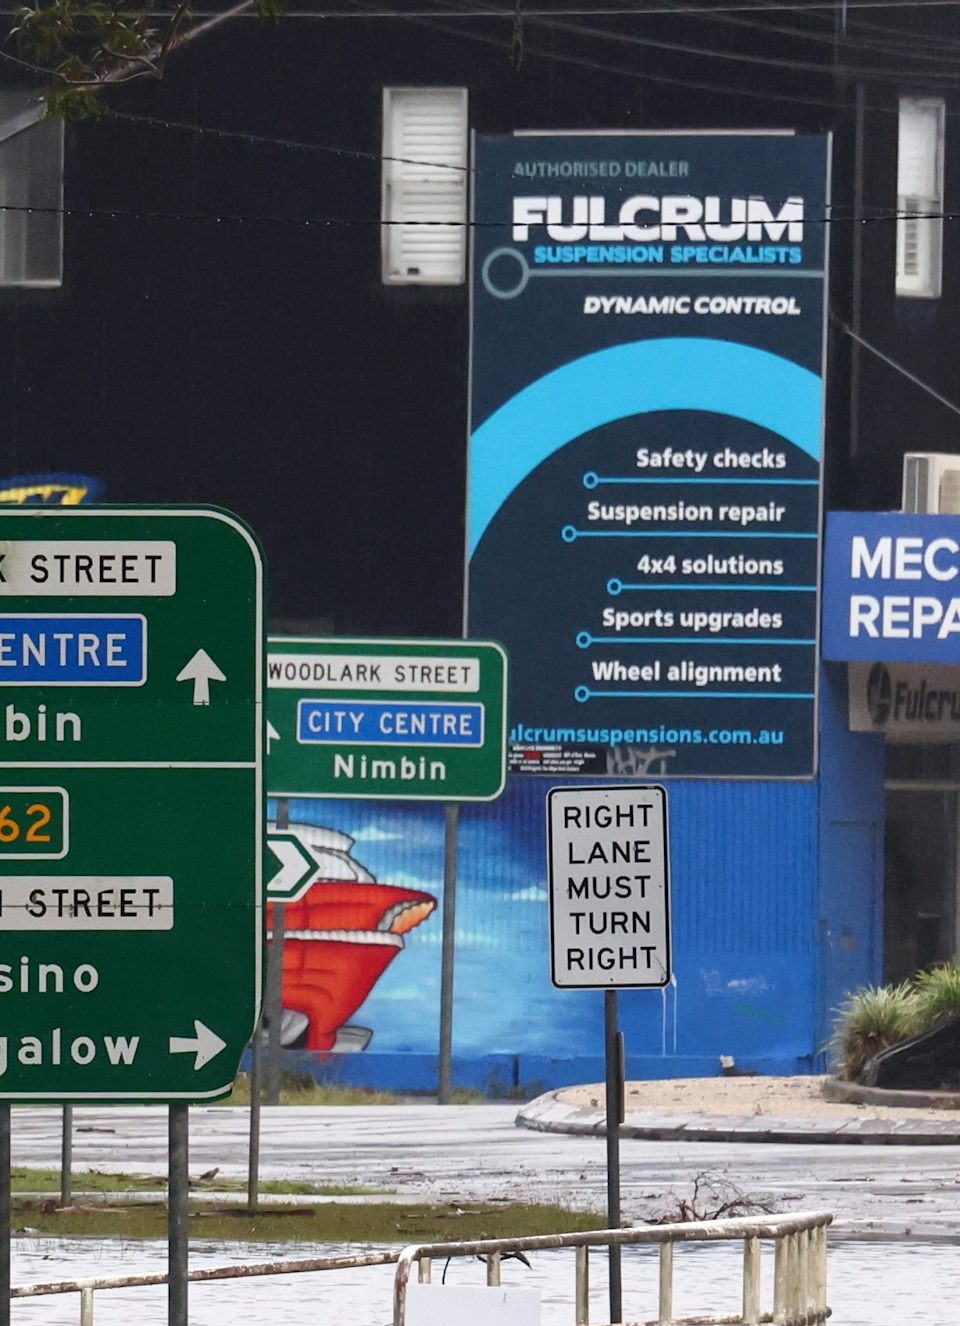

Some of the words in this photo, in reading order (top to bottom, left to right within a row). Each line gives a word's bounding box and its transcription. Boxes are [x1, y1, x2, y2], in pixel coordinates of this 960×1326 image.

[515, 161, 621, 177] AUTHORISED
[625, 161, 688, 177] DEALER
[513, 195, 803, 241] FULCRUM
[535, 246, 663, 263] SUSPENSION
[671, 246, 801, 263] SPECIALISTS
[584, 296, 690, 313] DYNAMIC
[694, 296, 800, 314] CONTROL
[637, 448, 707, 472] Safety
[714, 448, 786, 468] checks
[588, 501, 712, 525] Suspension
[719, 502, 785, 525] repair
[31, 555, 162, 583] STREET
[637, 555, 676, 573] 4x4
[682, 554, 783, 574] solutions
[851, 536, 959, 581] MEC
[603, 608, 674, 631] Sports
[680, 608, 782, 632] upgrades
[269, 663, 381, 682] WOODLARK
[395, 665, 471, 685] STREET
[592, 661, 660, 680] Wheel
[667, 661, 781, 686] alignment
[309, 711, 364, 732] CITY
[380, 713, 472, 735] CENTRE
[335, 754, 445, 780] Nimbin
[564, 805, 653, 828] RIGHT
[569, 841, 651, 864] LANE
[568, 875, 650, 899] MUST
[28, 889, 160, 918] STREET
[570, 911, 650, 934] TURN
[567, 947, 656, 970] RIGHT
